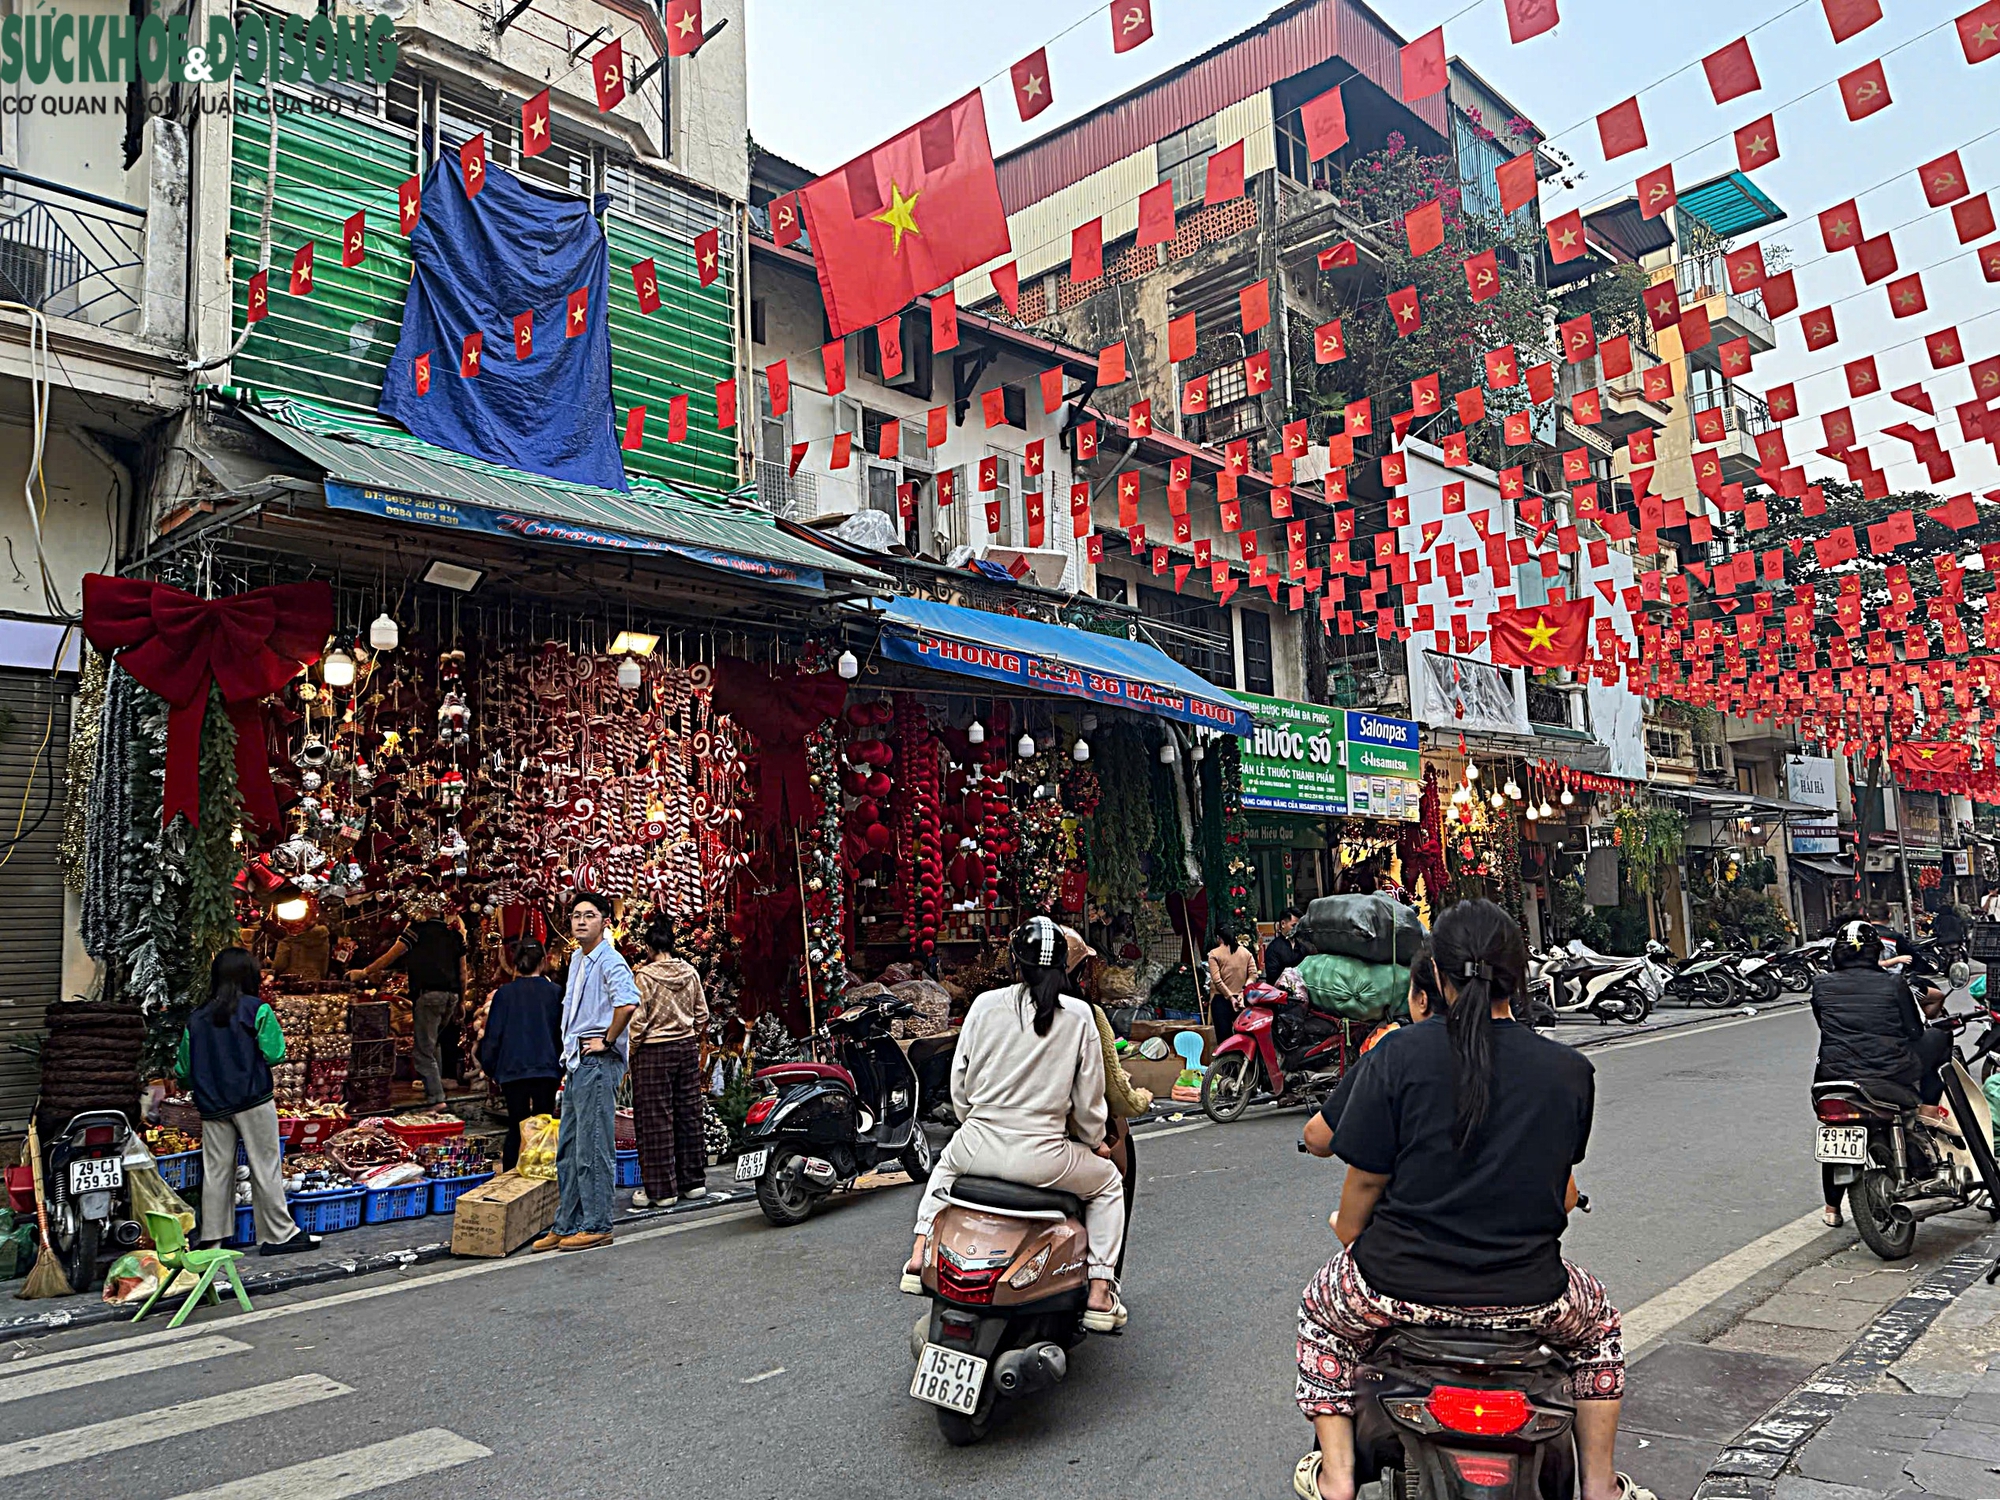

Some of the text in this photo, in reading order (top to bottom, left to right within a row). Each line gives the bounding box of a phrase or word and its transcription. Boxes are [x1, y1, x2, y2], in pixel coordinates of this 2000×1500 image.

[918, 637, 1020, 674] PHONG
[1089, 673, 1120, 695] 36
[1190, 700, 1237, 726] RƯƠI
[1360, 716, 1407, 744] Salonpas
[1308, 728, 1332, 764] SỐ
[1336, 740, 1348, 767] 1
[1360, 751, 1407, 771] Hisamitsu
[1267, 765, 1291, 779] THUỐC
[1823, 1143, 1857, 1156] 4140
[76, 1173, 119, 1191] 259.36
[930, 1351, 976, 1383] 15-C1
[918, 1373, 976, 1409] 186.26
